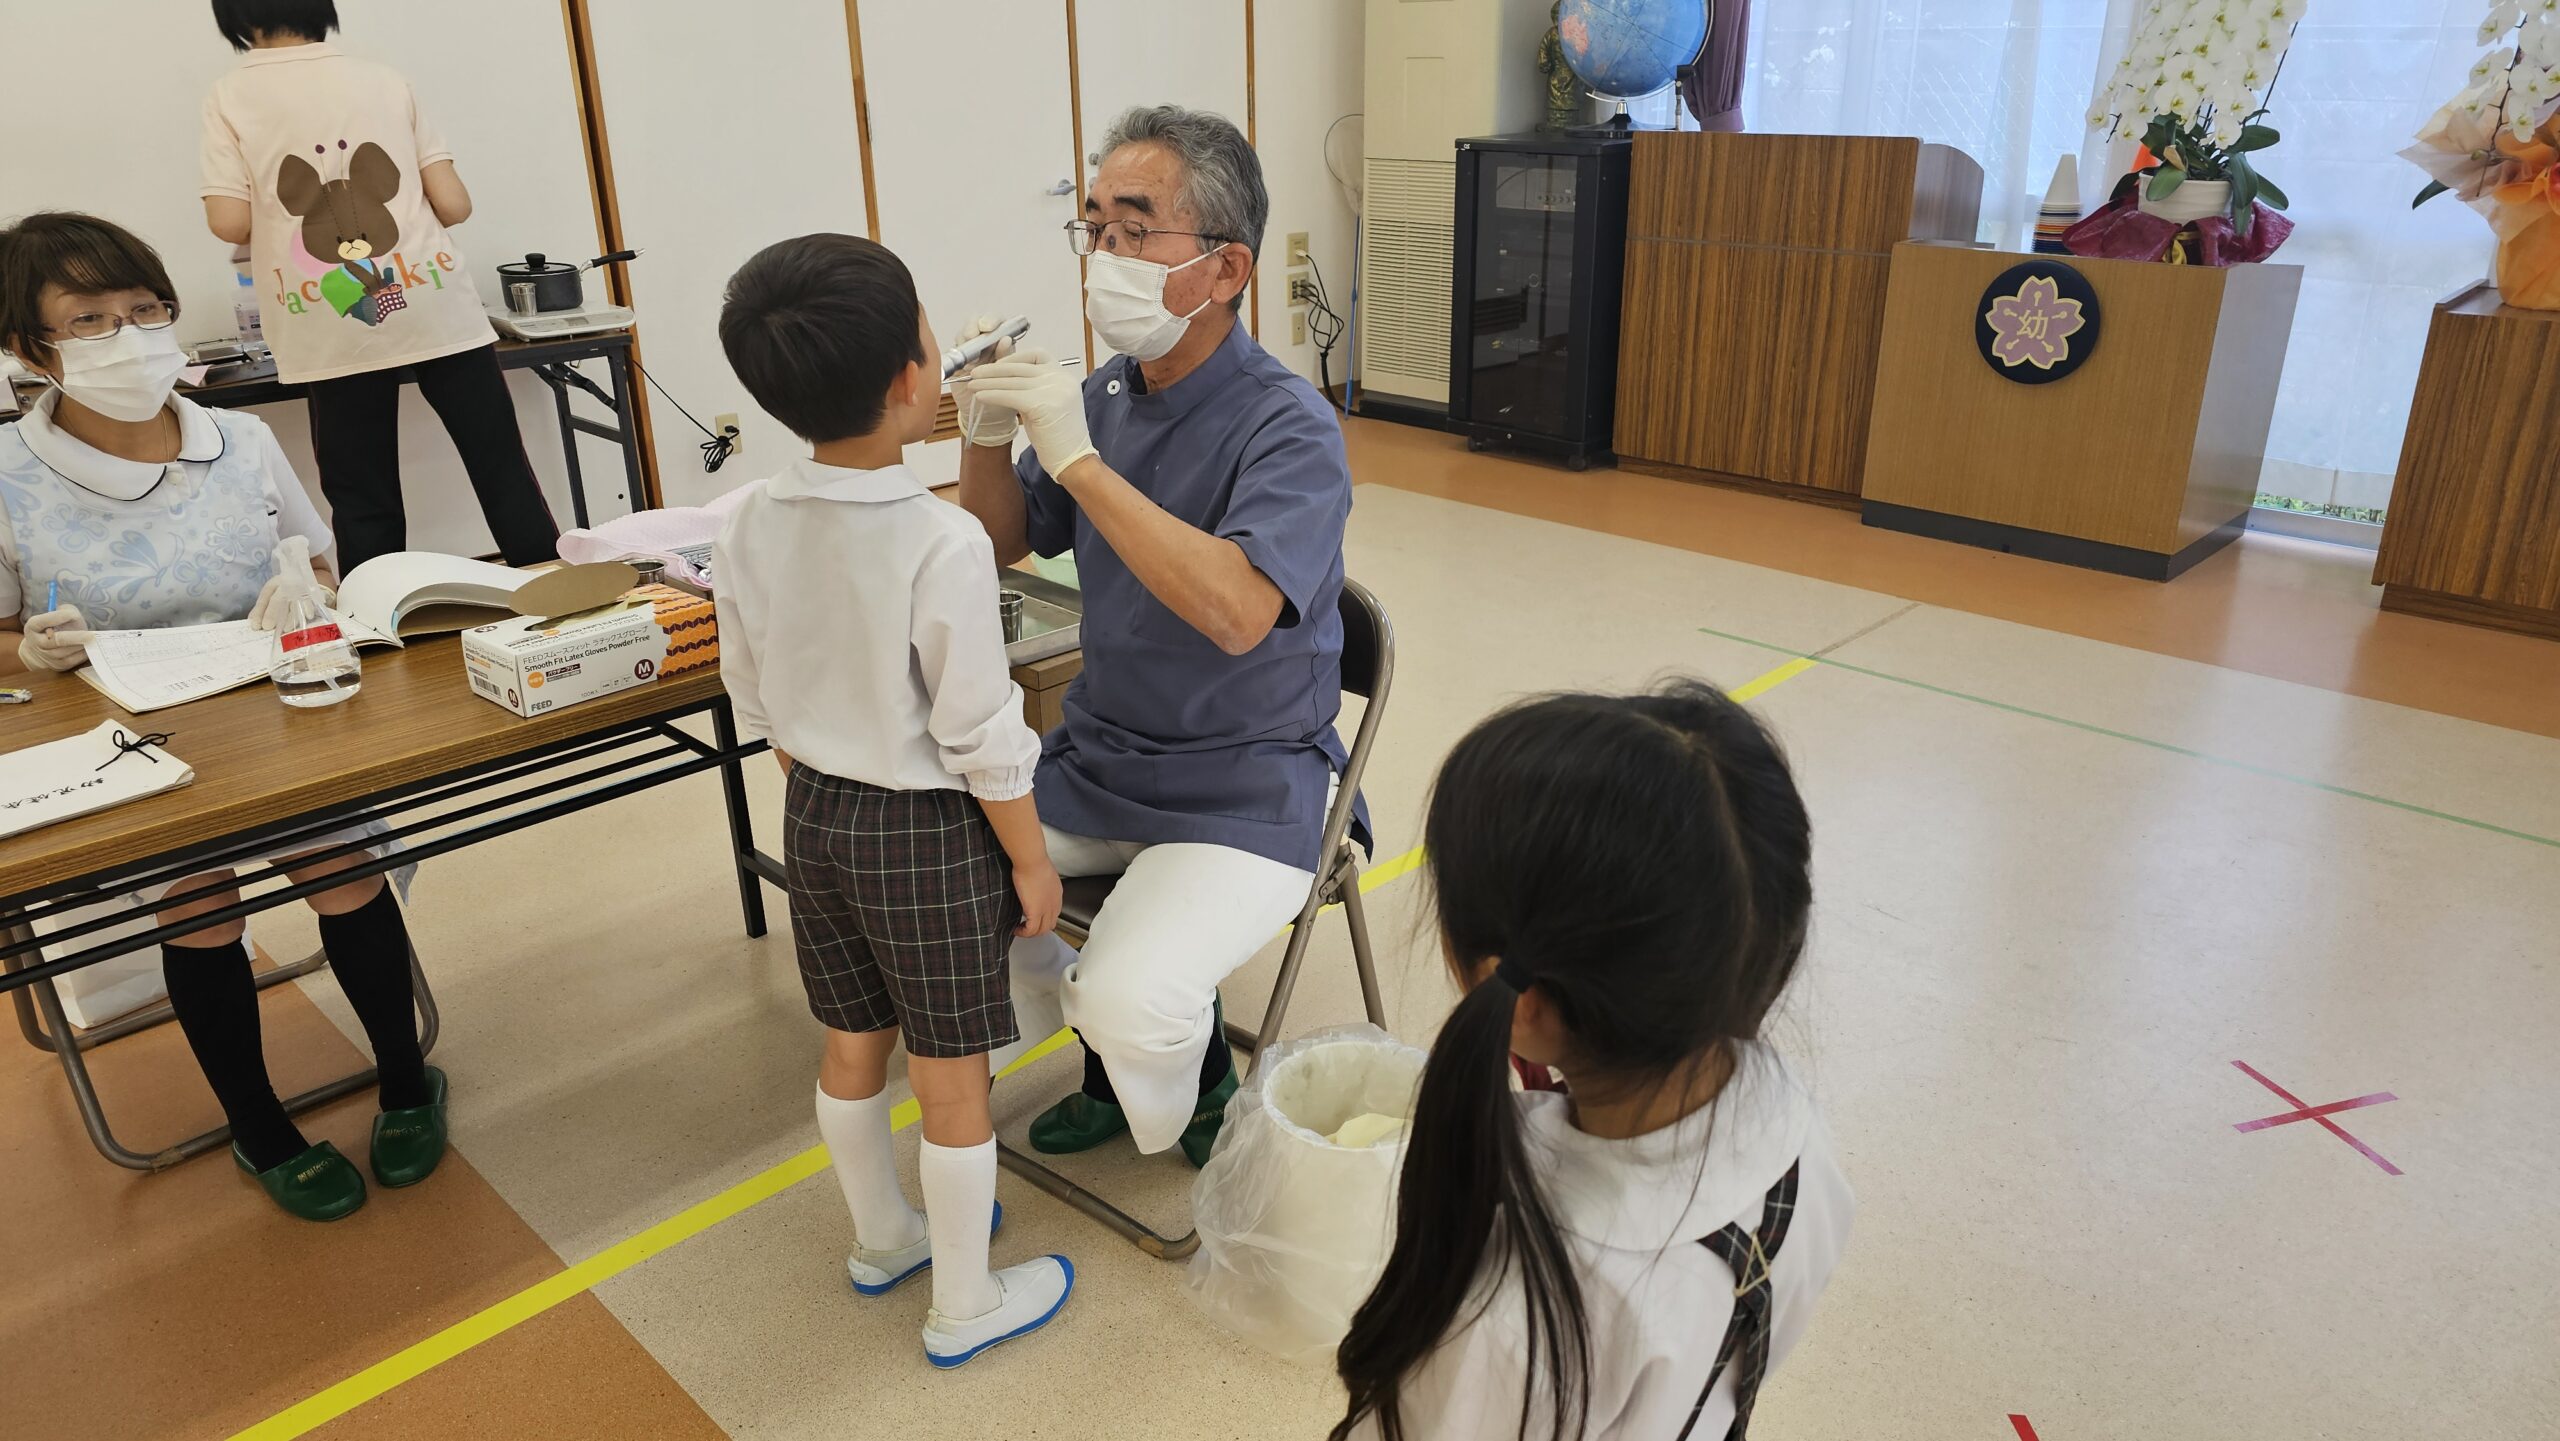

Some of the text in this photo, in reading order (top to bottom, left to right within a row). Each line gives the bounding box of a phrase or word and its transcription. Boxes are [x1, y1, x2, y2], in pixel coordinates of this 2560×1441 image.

[2017, 309, 2049, 340] 幼
[524, 659, 553, 672] Smooth
[564, 652, 584, 662] Latex
[585, 646, 608, 656] Gloves
[608, 639, 634, 650] Powder
[634, 635, 650, 643] Free
[638, 661, 651, 674] M
[531, 700, 552, 711] FEED
